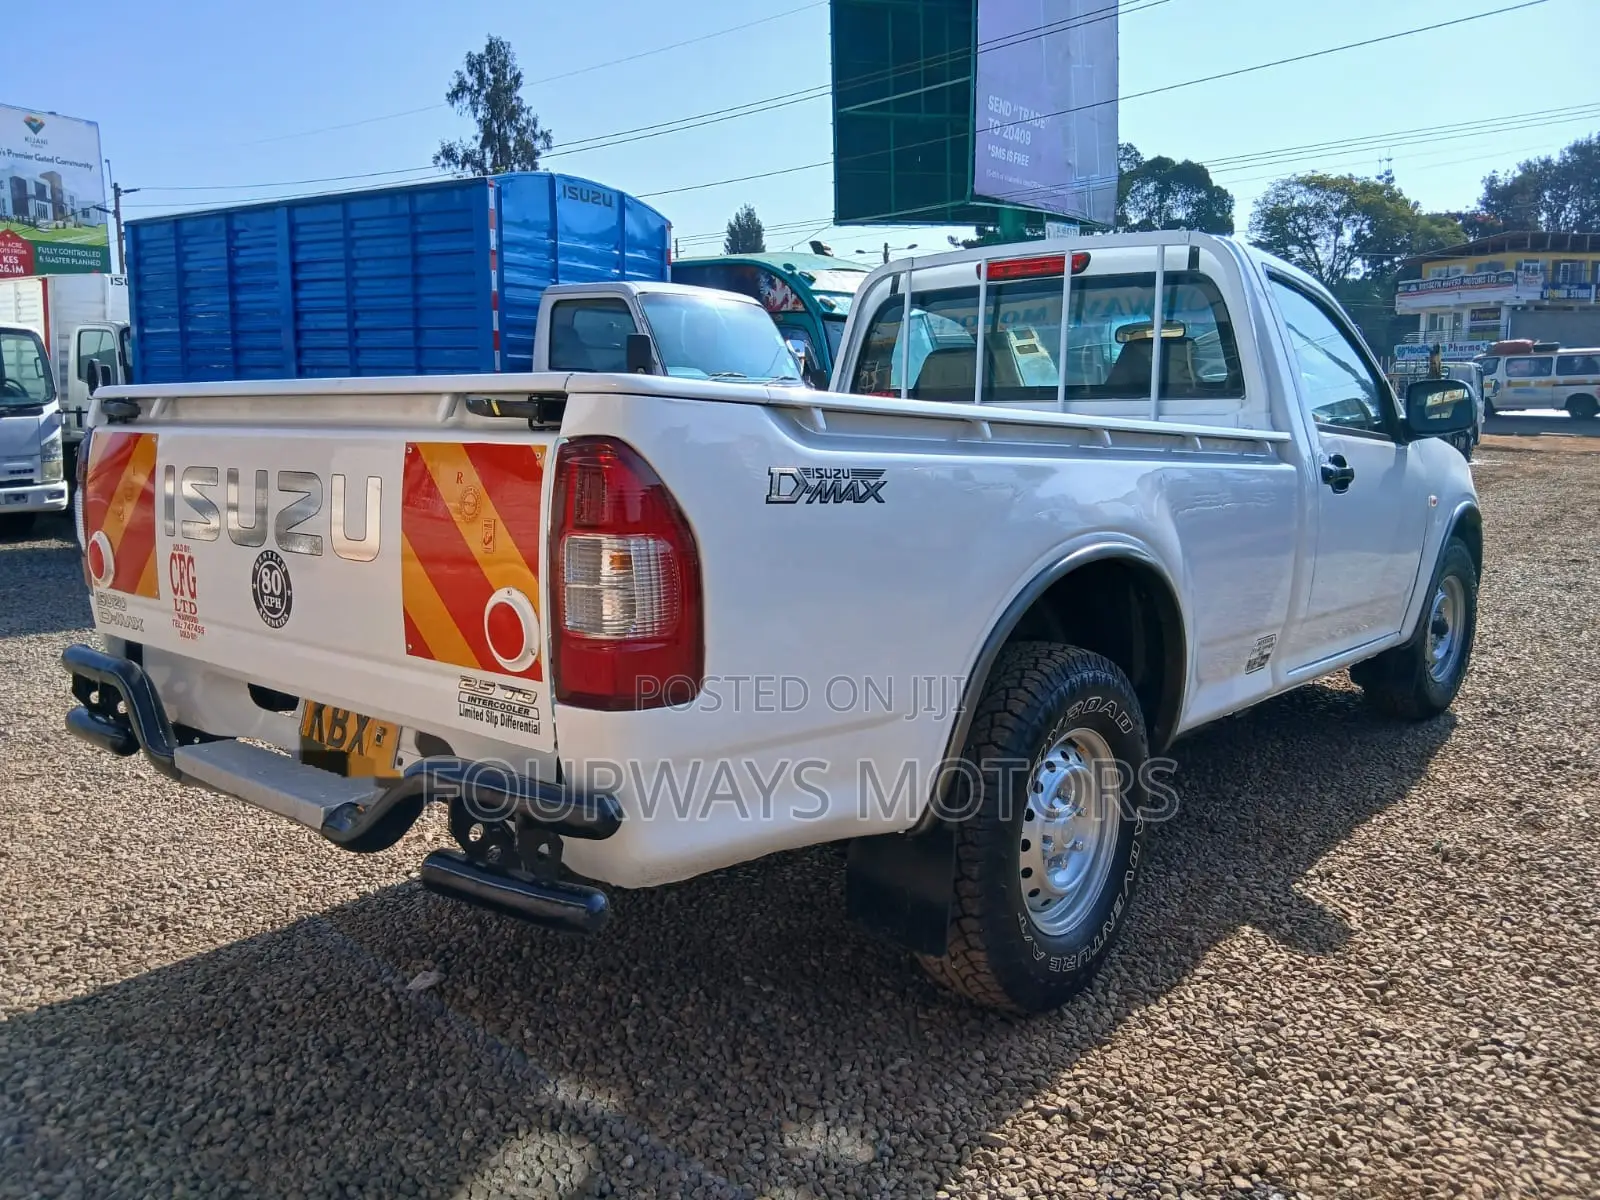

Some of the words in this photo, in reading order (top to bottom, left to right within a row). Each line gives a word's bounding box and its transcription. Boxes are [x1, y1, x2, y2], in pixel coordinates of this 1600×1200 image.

[988, 95, 1012, 117] SEND
[24, 136, 48, 145] KIJANI
[988, 117, 1000, 135] TO
[1002, 122, 1031, 146] 20409
[7, 148, 34, 160] Premier
[34, 153, 55, 163] Gated
[55, 156, 94, 172] Community
[1006, 150, 1014, 162] IS
[1013, 152, 1030, 167] FREE
[563, 184, 613, 207] ISUZU
[3, 255, 19, 264] KES
[38, 246, 58, 254] FULLY
[59, 247, 101, 258] CONTROLLED
[45, 256, 71, 265] MASTER
[72, 257, 101, 267] PLANNED
[0, 264, 24, 274] 26.1M
[456, 471, 464, 484] R
[811, 468, 850, 479] ISUZU
[766, 467, 888, 504] D-MAX
[164, 465, 382, 563] ISUZU
[169, 552, 197, 600] CFG
[261, 567, 282, 596] 80
[173, 598, 198, 616] LTD
[263, 595, 282, 609] KPH
[467, 695, 531, 716] INTERCOOLER
[309, 703, 371, 757] KBX
[459, 703, 484, 722] Limited
[485, 710, 499, 729] Slip
[500, 713, 541, 736] Differential
